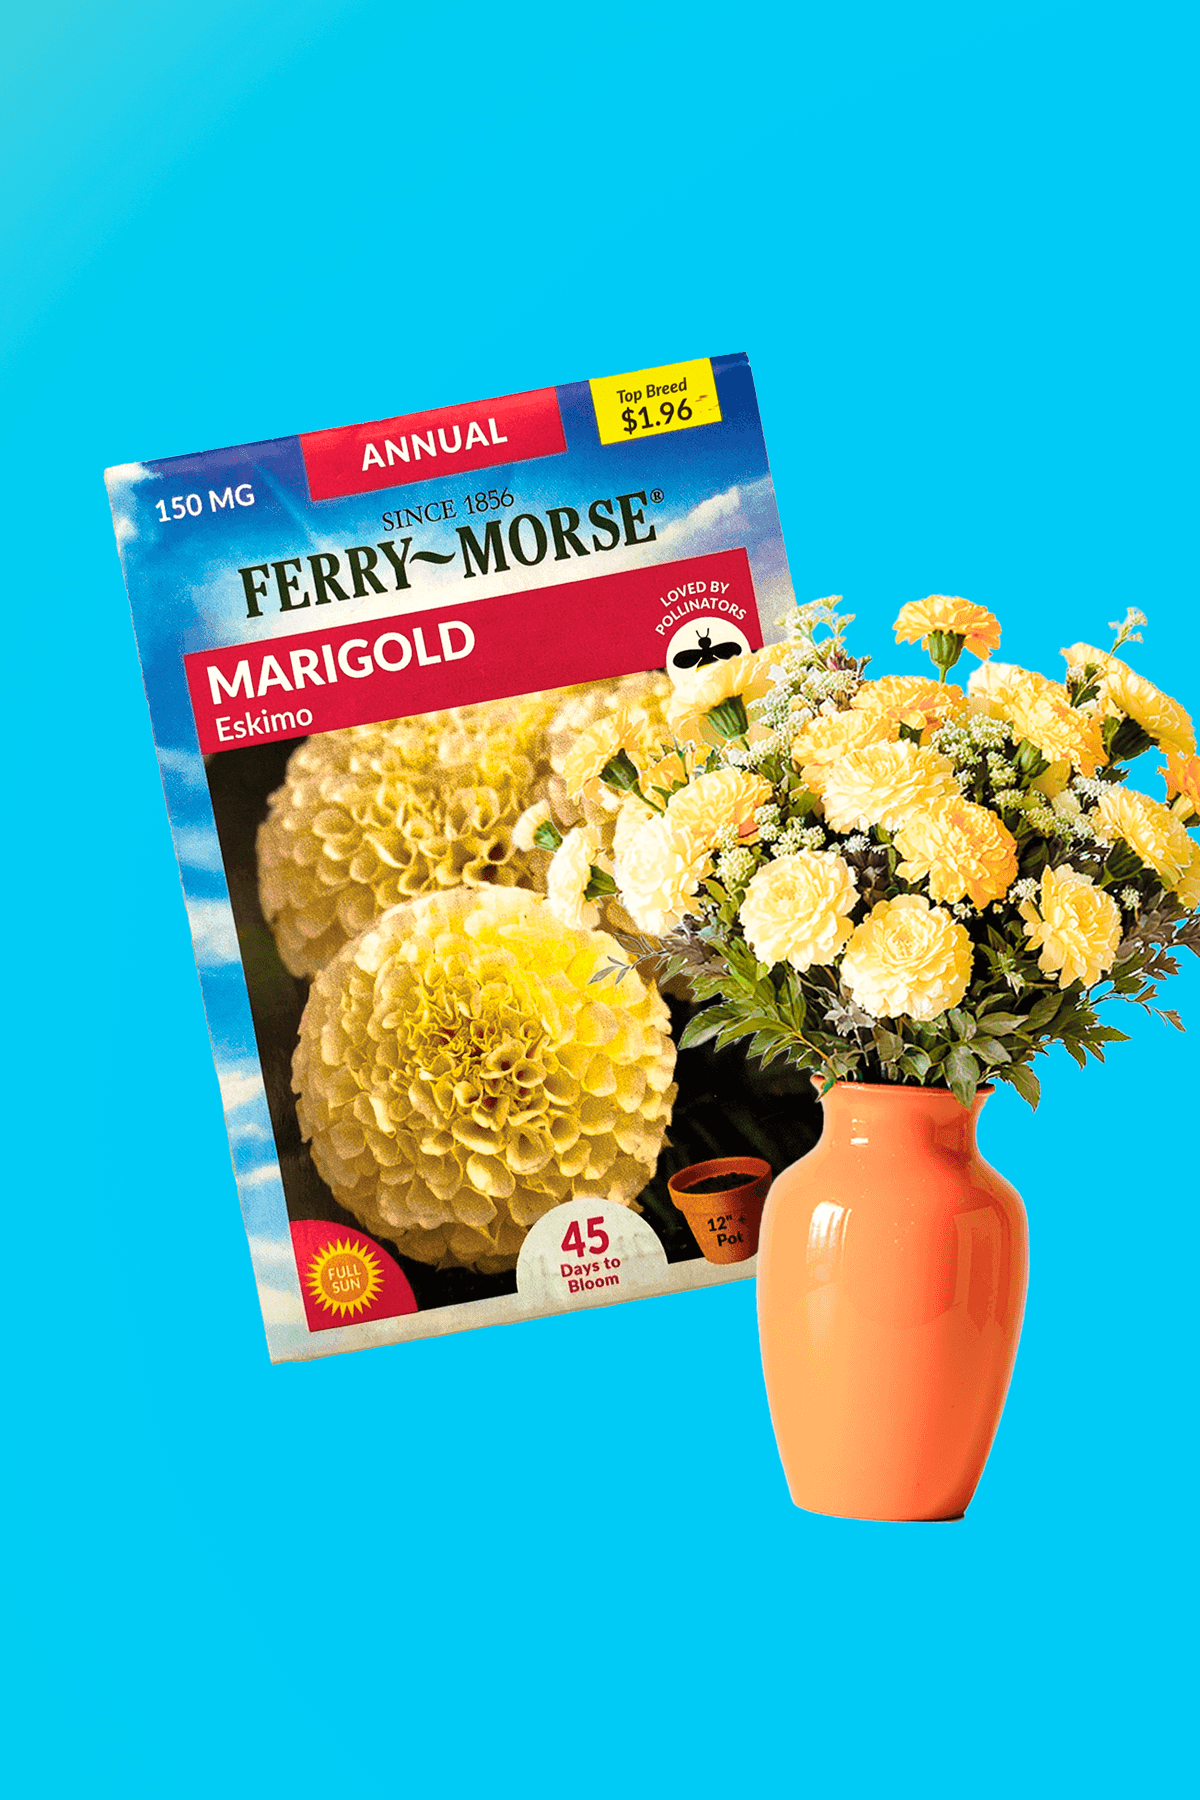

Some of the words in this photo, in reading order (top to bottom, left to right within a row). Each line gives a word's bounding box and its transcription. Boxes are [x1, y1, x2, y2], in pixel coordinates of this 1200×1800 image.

[616, 389, 642, 404] Top
[646, 377, 687, 398] Breed
[621, 398, 693, 435] $1.96
[361, 417, 508, 471] ANNUAL
[154, 493, 202, 523] 150
[209, 484, 255, 513] MG
[382, 499, 457, 532] SINCE
[463, 487, 515, 515] 1856
[660, 581, 707, 607] LOVED
[710, 581, 730, 594] BY
[655, 597, 747, 636] POLLINATORS
[206, 620, 476, 705] MARIGOLD
[215, 708, 313, 742] Eskimo
[561, 1216, 610, 1258] 45
[717, 1231, 744, 1247] Pot
[328, 1264, 361, 1280] FULL
[560, 1262, 600, 1278] Days
[603, 1257, 621, 1270] to
[568, 1275, 620, 1293] Bloom
[332, 1278, 360, 1293] SUN
